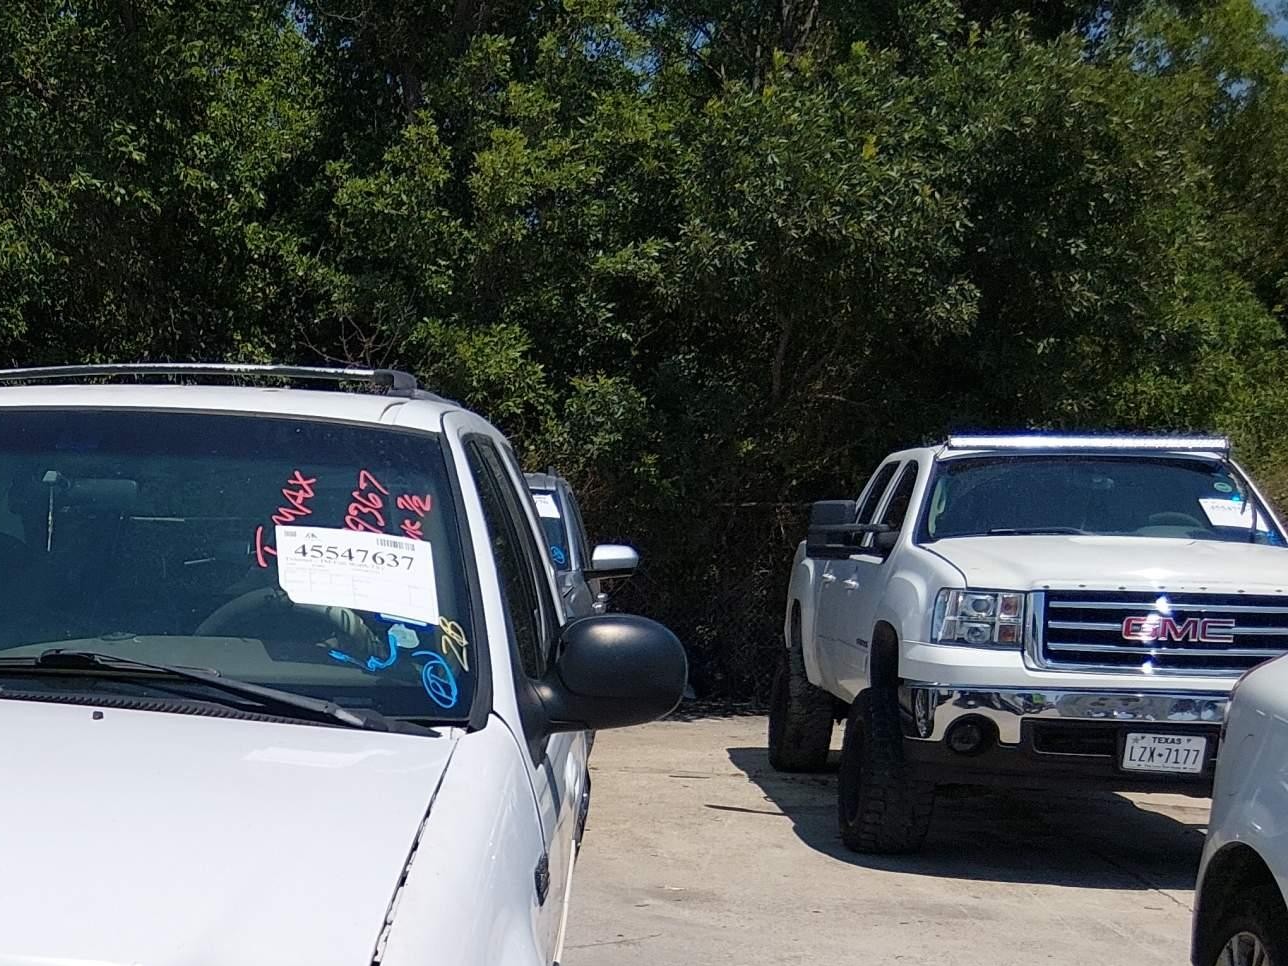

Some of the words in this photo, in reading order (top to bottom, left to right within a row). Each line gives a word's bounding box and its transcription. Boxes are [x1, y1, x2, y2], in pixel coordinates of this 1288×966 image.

[294, 544, 414, 571] 45547637
[1122, 616, 1235, 643] GMC
[1152, 736, 1182, 745] TEXAS
